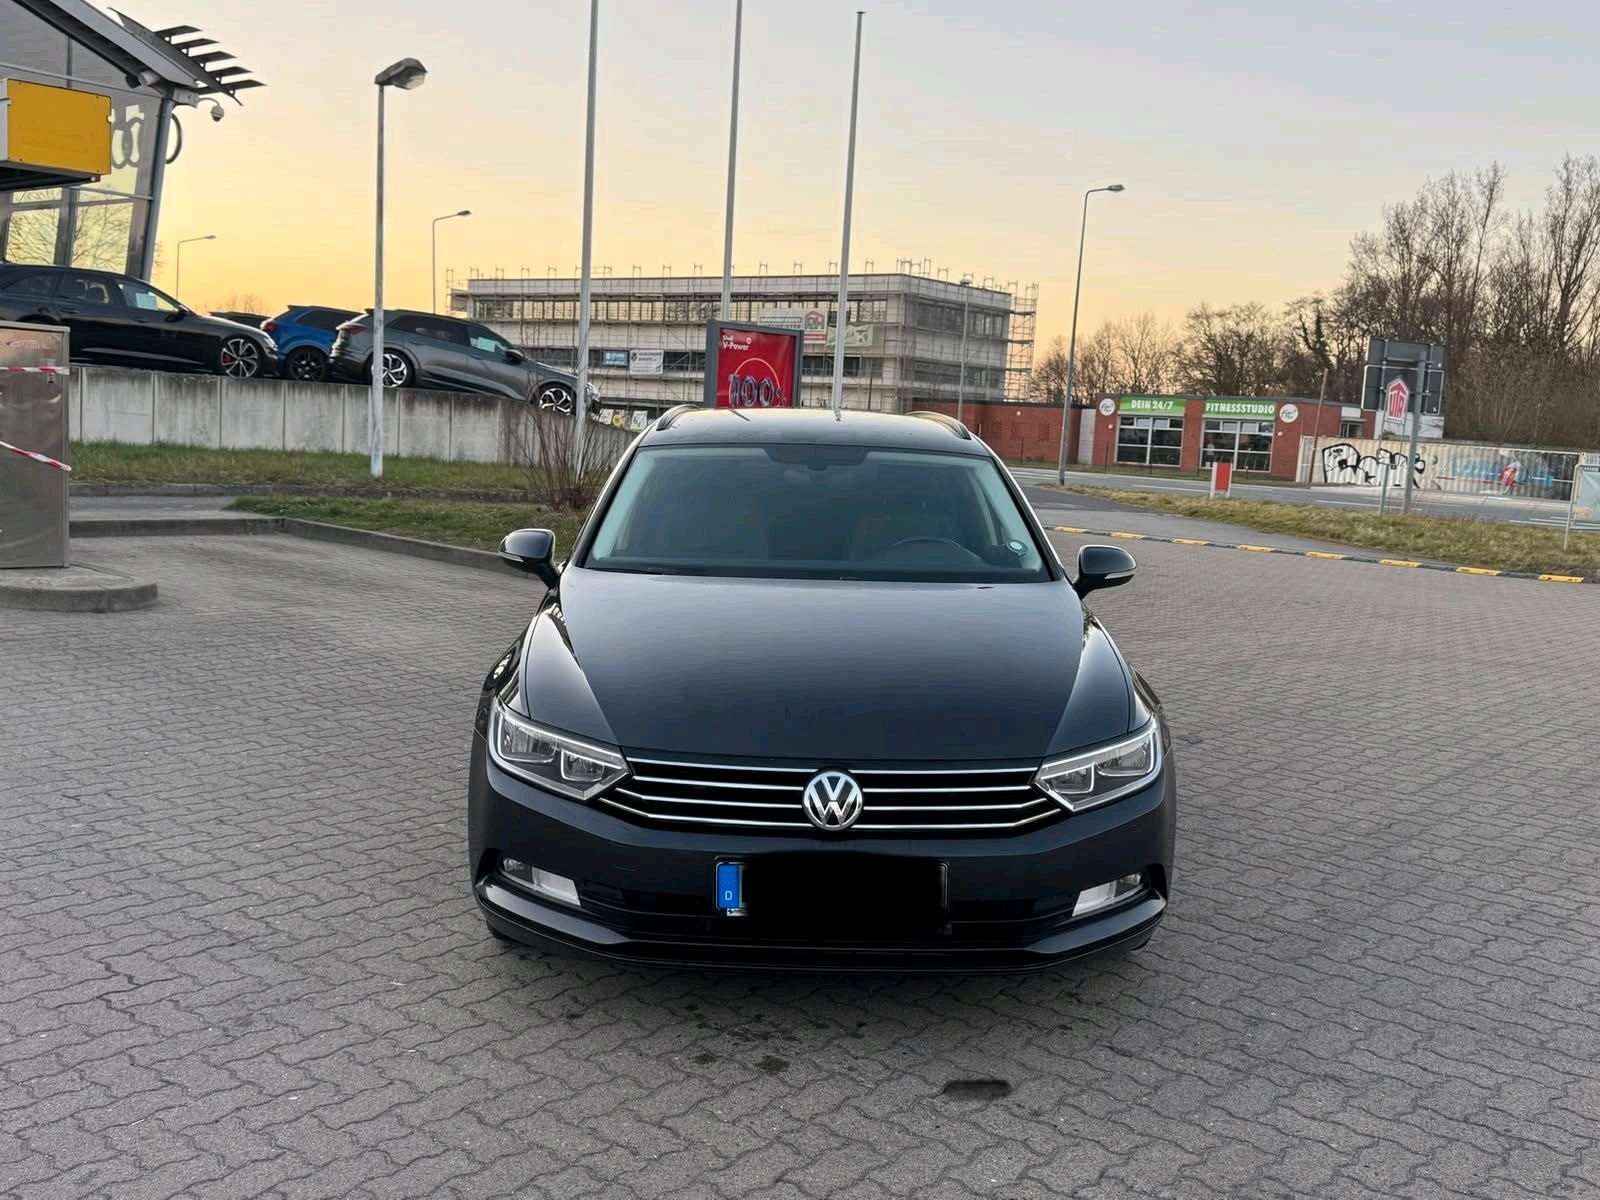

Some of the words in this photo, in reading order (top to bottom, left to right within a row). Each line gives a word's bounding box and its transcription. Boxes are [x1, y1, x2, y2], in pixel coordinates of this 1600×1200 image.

[722, 341, 750, 351] V-Power
[1131, 400, 1151, 409] DEIN
[1152, 401, 1174, 410] 24/7
[1205, 402, 1275, 414] FITNESSSTUDIO
[724, 890, 733, 901] D
